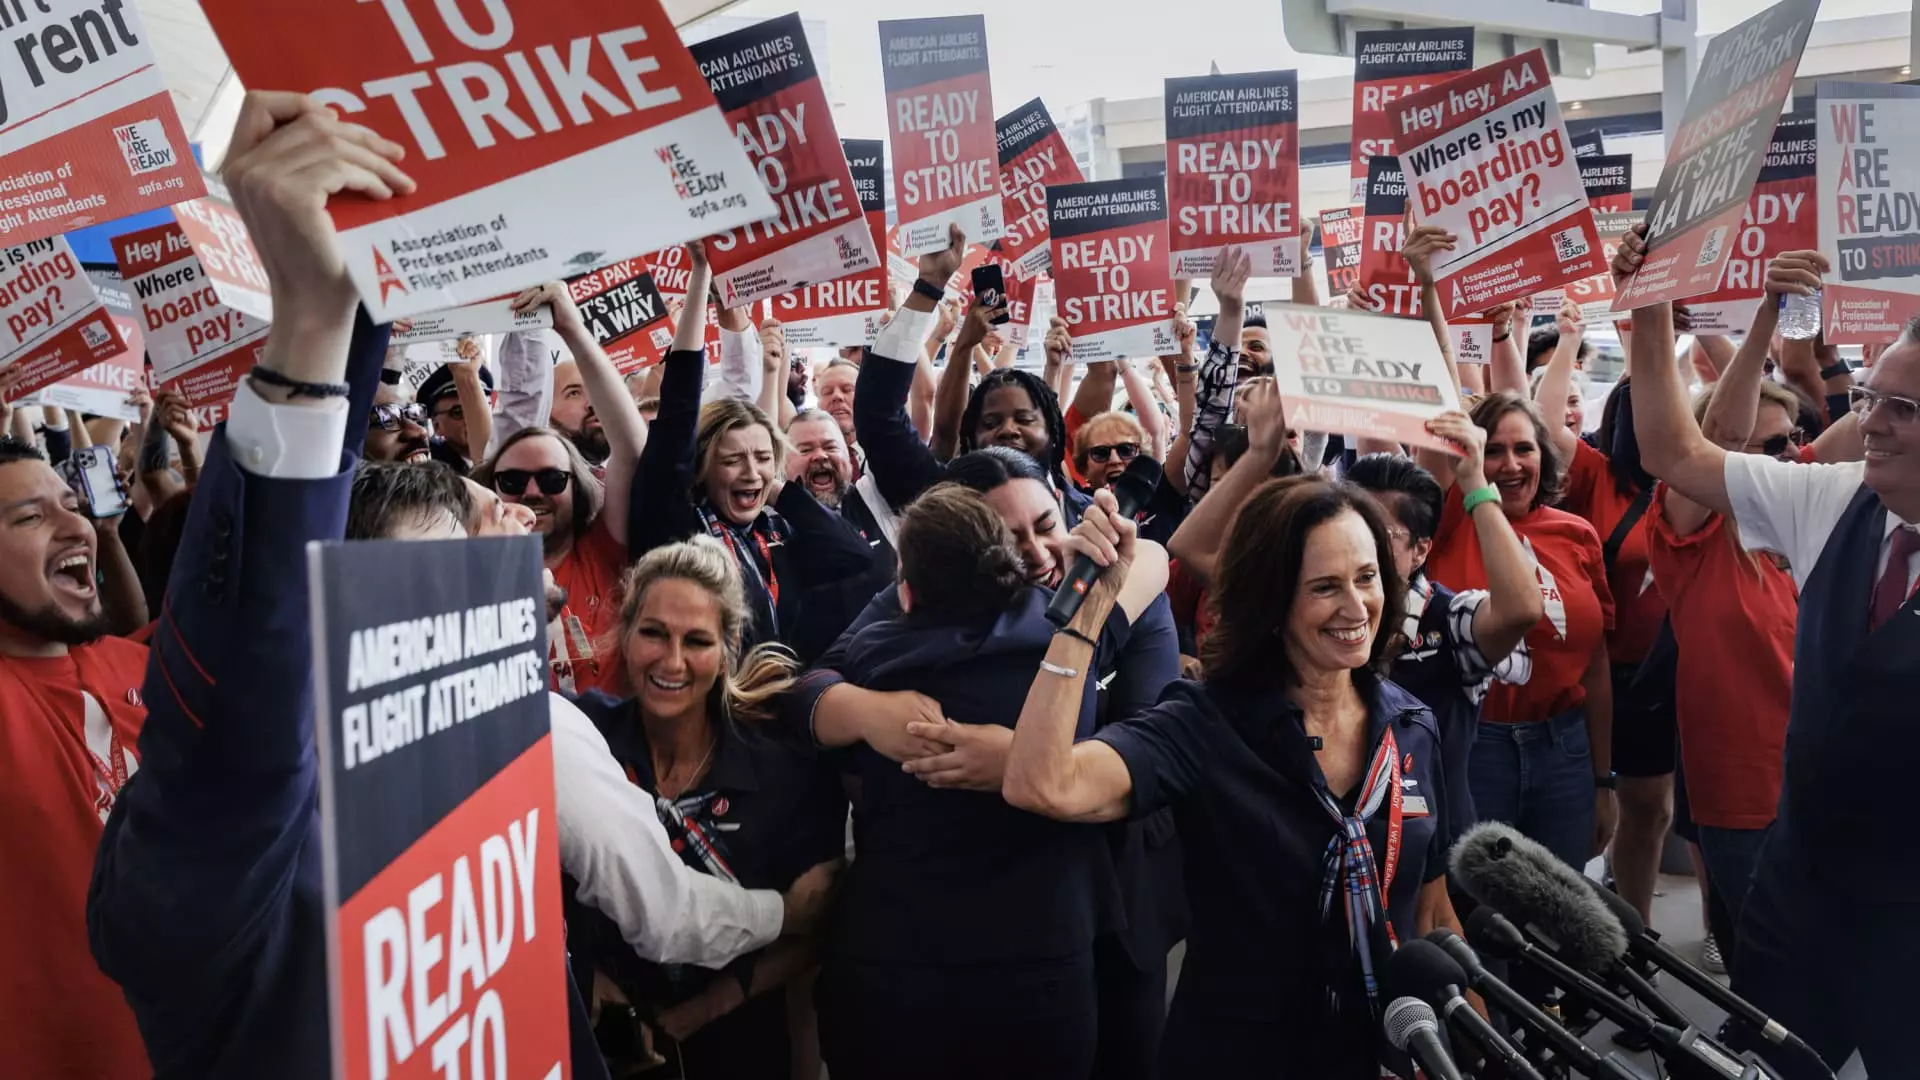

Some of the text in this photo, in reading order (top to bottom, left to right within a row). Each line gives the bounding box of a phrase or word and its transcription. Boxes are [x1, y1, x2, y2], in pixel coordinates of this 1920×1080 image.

[14, 0, 138, 87] rent
[357, 0, 514, 64] TO
[890, 32, 978, 50] AMERICAN AIRLINES
[1363, 39, 1465, 54] AMERICAN AIRLINES
[732, 34, 794, 70] AIRLINES
[888, 46, 983, 67] FLIGHT ATTENDANTS:
[1359, 49, 1467, 65] FLIGHT ATTENDANTS:
[1703, 14, 1773, 83] MORE
[1728, 22, 1801, 96] WORK
[709, 52, 804, 93] ATTENDANTS:
[1172, 98, 1293, 119] FLIGHT ATTENDANTS:
[1176, 86, 1289, 104] AMERICAN AIRLINES
[1400, 102, 1445, 136] Hey
[1448, 83, 1497, 117] hey,
[1501, 62, 1538, 97] AA
[896, 89, 979, 134] READY
[1005, 110, 1042, 137] AIRLINES
[1830, 103, 1876, 144] WE
[117, 126, 140, 141] WE
[735, 103, 808, 156] ADY
[997, 119, 1049, 153] TTENDANTS:
[1409, 130, 1482, 178] Where
[1484, 118, 1508, 143] is
[1512, 100, 1548, 131] my
[1680, 102, 1730, 156] LESS
[127, 139, 151, 155] ARE
[656, 143, 684, 166] WE
[924, 127, 960, 165] TO
[1178, 138, 1283, 175] READY
[1670, 118, 1759, 193] IT'S THE
[1767, 139, 1817, 154] IRLINES
[57, 162, 73, 178] of
[130, 149, 171, 173] READY
[670, 160, 699, 184] ARE
[1000, 145, 1059, 200] EADY
[1417, 127, 1564, 217] boarding
[1581, 166, 1624, 178] AIRLINES
[1838, 144, 1890, 194] ARE
[138, 177, 184, 197] apfa.org
[676, 171, 727, 200] READY
[903, 158, 993, 206] STRIKE
[1208, 172, 1251, 204] TO
[28, 192, 107, 223] Attendants
[688, 192, 747, 219] apfa.org
[1012, 183, 1047, 213] TO
[1053, 200, 1161, 221] FLIGHT ATTENDANTS:
[1056, 189, 1157, 209] AMERICAN AIRLINES
[1468, 172, 1541, 245] pay?
[1644, 150, 1758, 244] AA WAY
[1004, 208, 1048, 247] STR
[1179, 202, 1292, 236] STRIKE
[391, 214, 508, 255] Association of
[1553, 230, 1567, 242] WE
[1558, 239, 1574, 251] ARE
[5, 248, 26, 266] is
[124, 238, 162, 265] Hey
[398, 235, 503, 272] Professional
[1060, 234, 1155, 270] READY
[1559, 244, 1587, 260] READY
[1841, 244, 1920, 271] TO STRIK
[0, 250, 76, 309] arding
[134, 263, 195, 299] Where
[408, 246, 550, 292] Flight Attendants
[570, 257, 640, 301] ESS PAY:
[733, 265, 775, 284] Association of
[1090, 264, 1132, 294] TO
[1462, 257, 1524, 284] Association of
[1463, 270, 1519, 293] Professional
[1561, 259, 1593, 275] apfa.org
[607, 280, 641, 307] THE
[735, 276, 772, 290] Professional
[737, 279, 788, 298] Flight Attendants
[1465, 275, 1543, 303] Flight Attendants
[8, 285, 65, 343] pay?
[608, 294, 656, 333] WAY
[1064, 289, 1169, 324] STRIKE
[1841, 299, 1890, 311] Association of
[1842, 310, 1885, 321] Professional
[1283, 313, 1346, 333] WE
[1842, 320, 1899, 333] Flight Attendants
[1297, 332, 1366, 355] ARE
[84, 363, 136, 391] RIKE
[1297, 354, 1422, 381] READY
[1310, 378, 1438, 401] TO STRIKE
[348, 596, 537, 693] AMERICAN AIRLINES
[342, 649, 544, 770] FLIGHT ATTENDANTS:
[363, 807, 539, 1080] READY
[431, 988, 508, 1080] TO
